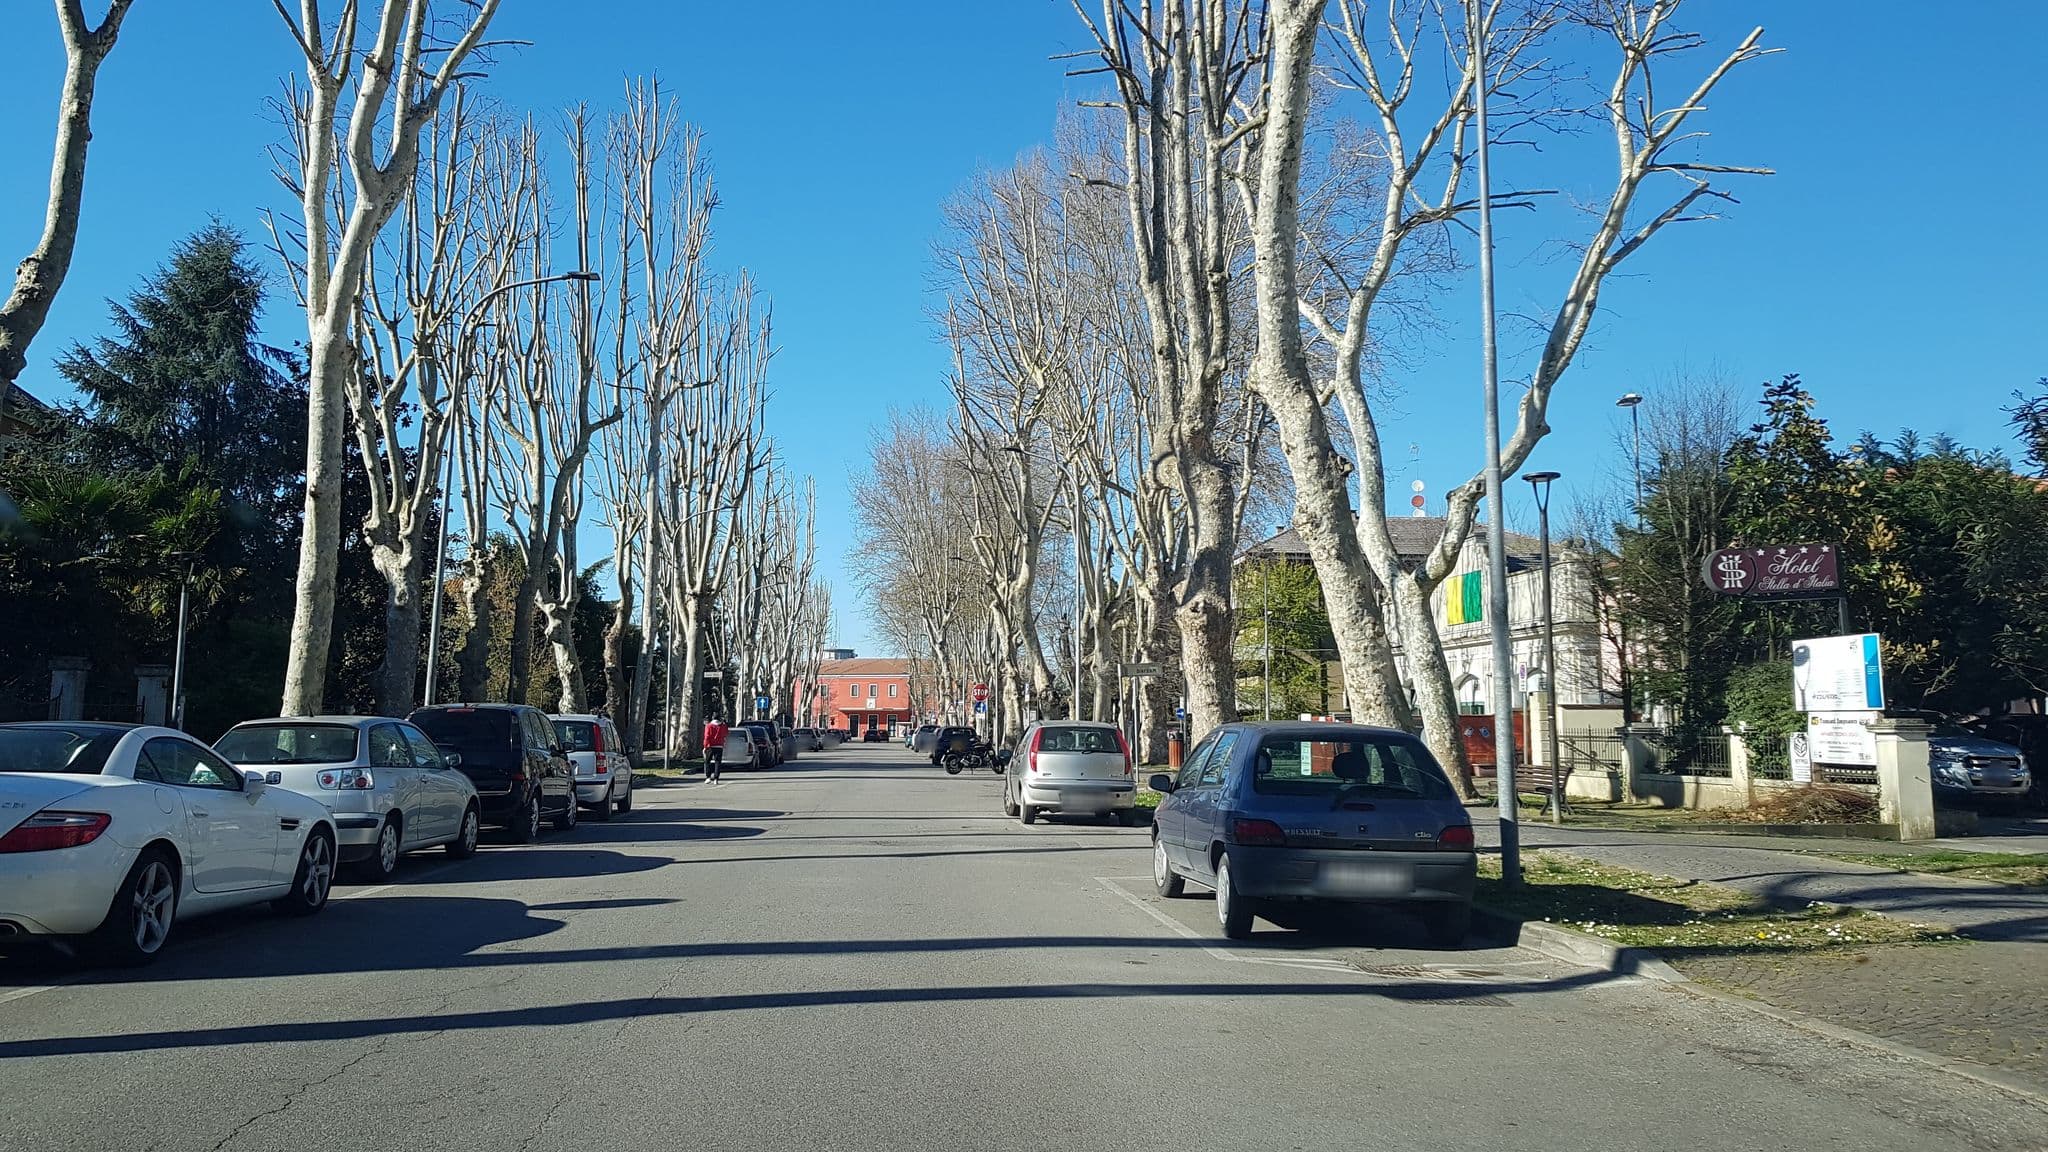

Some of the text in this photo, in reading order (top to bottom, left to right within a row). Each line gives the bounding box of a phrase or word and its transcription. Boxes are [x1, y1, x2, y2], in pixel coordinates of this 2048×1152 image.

[1768, 553, 1824, 575] Hotel
[1758, 576, 1790, 590] Stella
[973, 688, 988, 696] STOP
